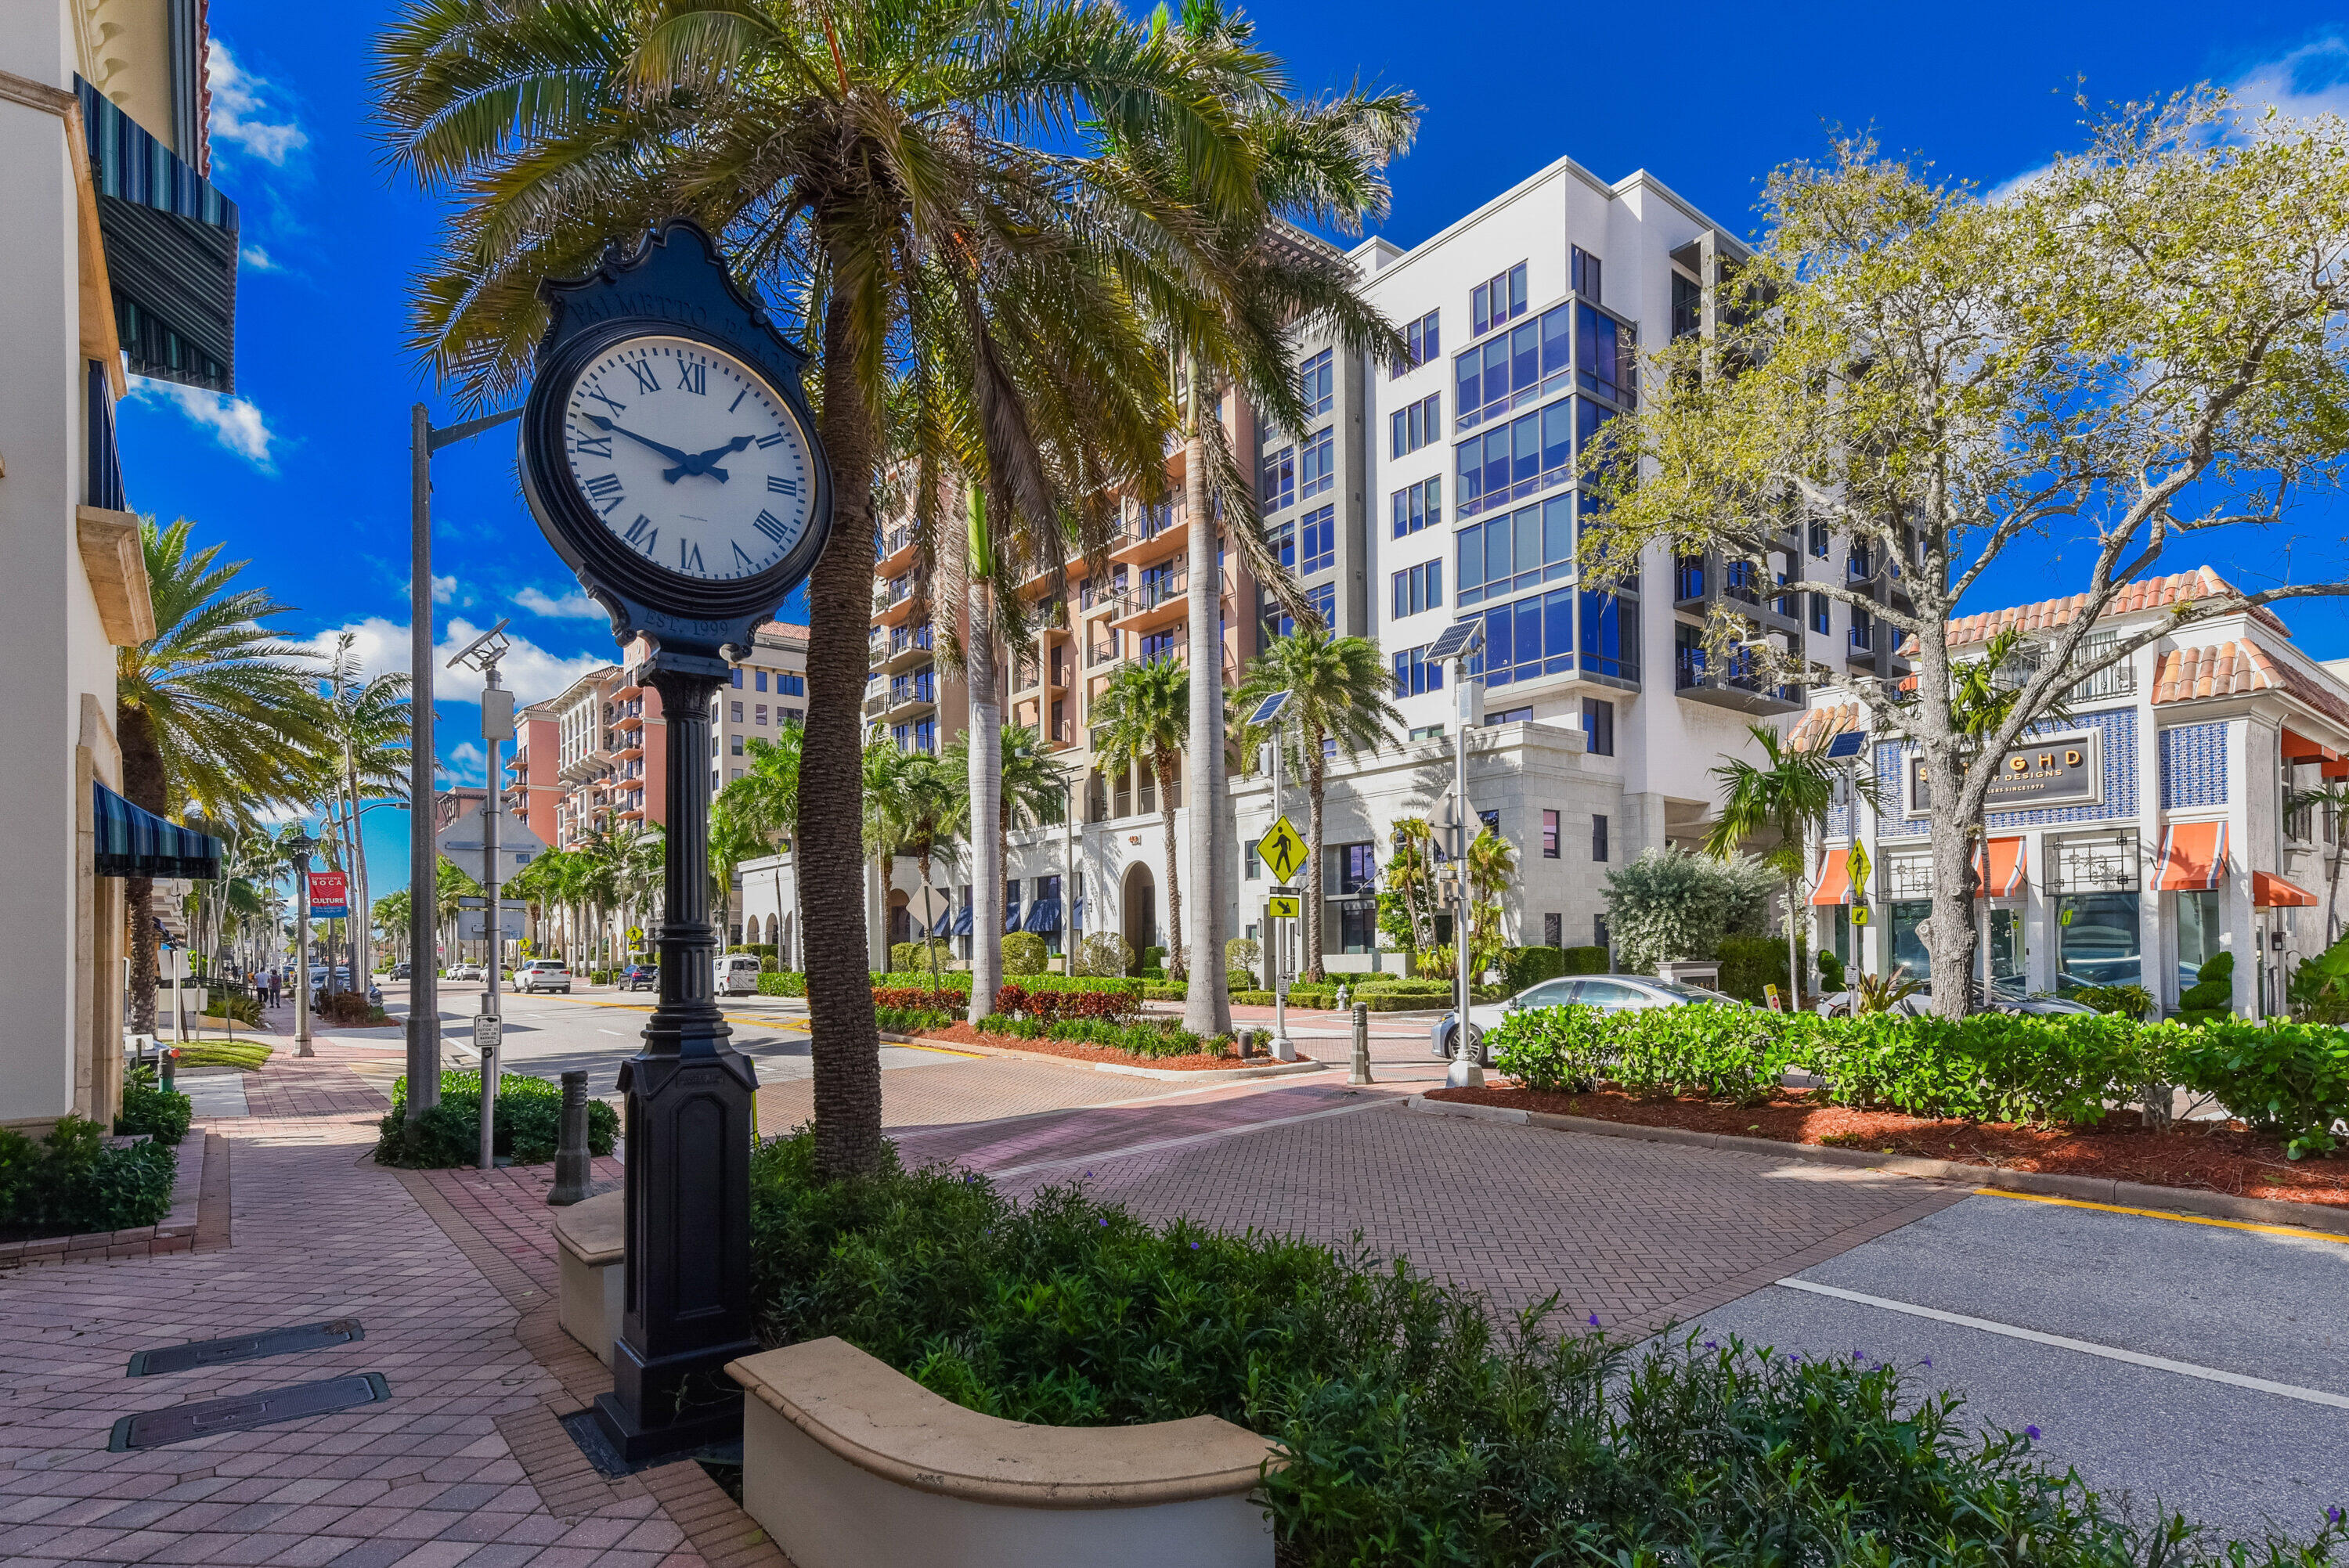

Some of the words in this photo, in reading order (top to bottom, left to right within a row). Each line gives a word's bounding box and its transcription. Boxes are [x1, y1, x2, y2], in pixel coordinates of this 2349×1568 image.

[570, 293, 707, 327] PALMETTO
[625, 359, 662, 396] XI
[677, 359, 706, 396] XII
[588, 383, 627, 419] X
[727, 387, 748, 415] I
[576, 428, 612, 460] IX
[756, 431, 785, 451] II
[584, 472, 626, 517] VIII
[767, 474, 798, 498] III
[623, 513, 660, 557] VII
[752, 508, 789, 546] IIII
[680, 537, 706, 573] VI
[730, 538, 753, 570] V
[644, 610, 684, 634] EST.
[693, 620, 729, 637] 1999
[1919, 750, 2081, 781] SGHD
[2004, 769, 2063, 782] DESIGNS
